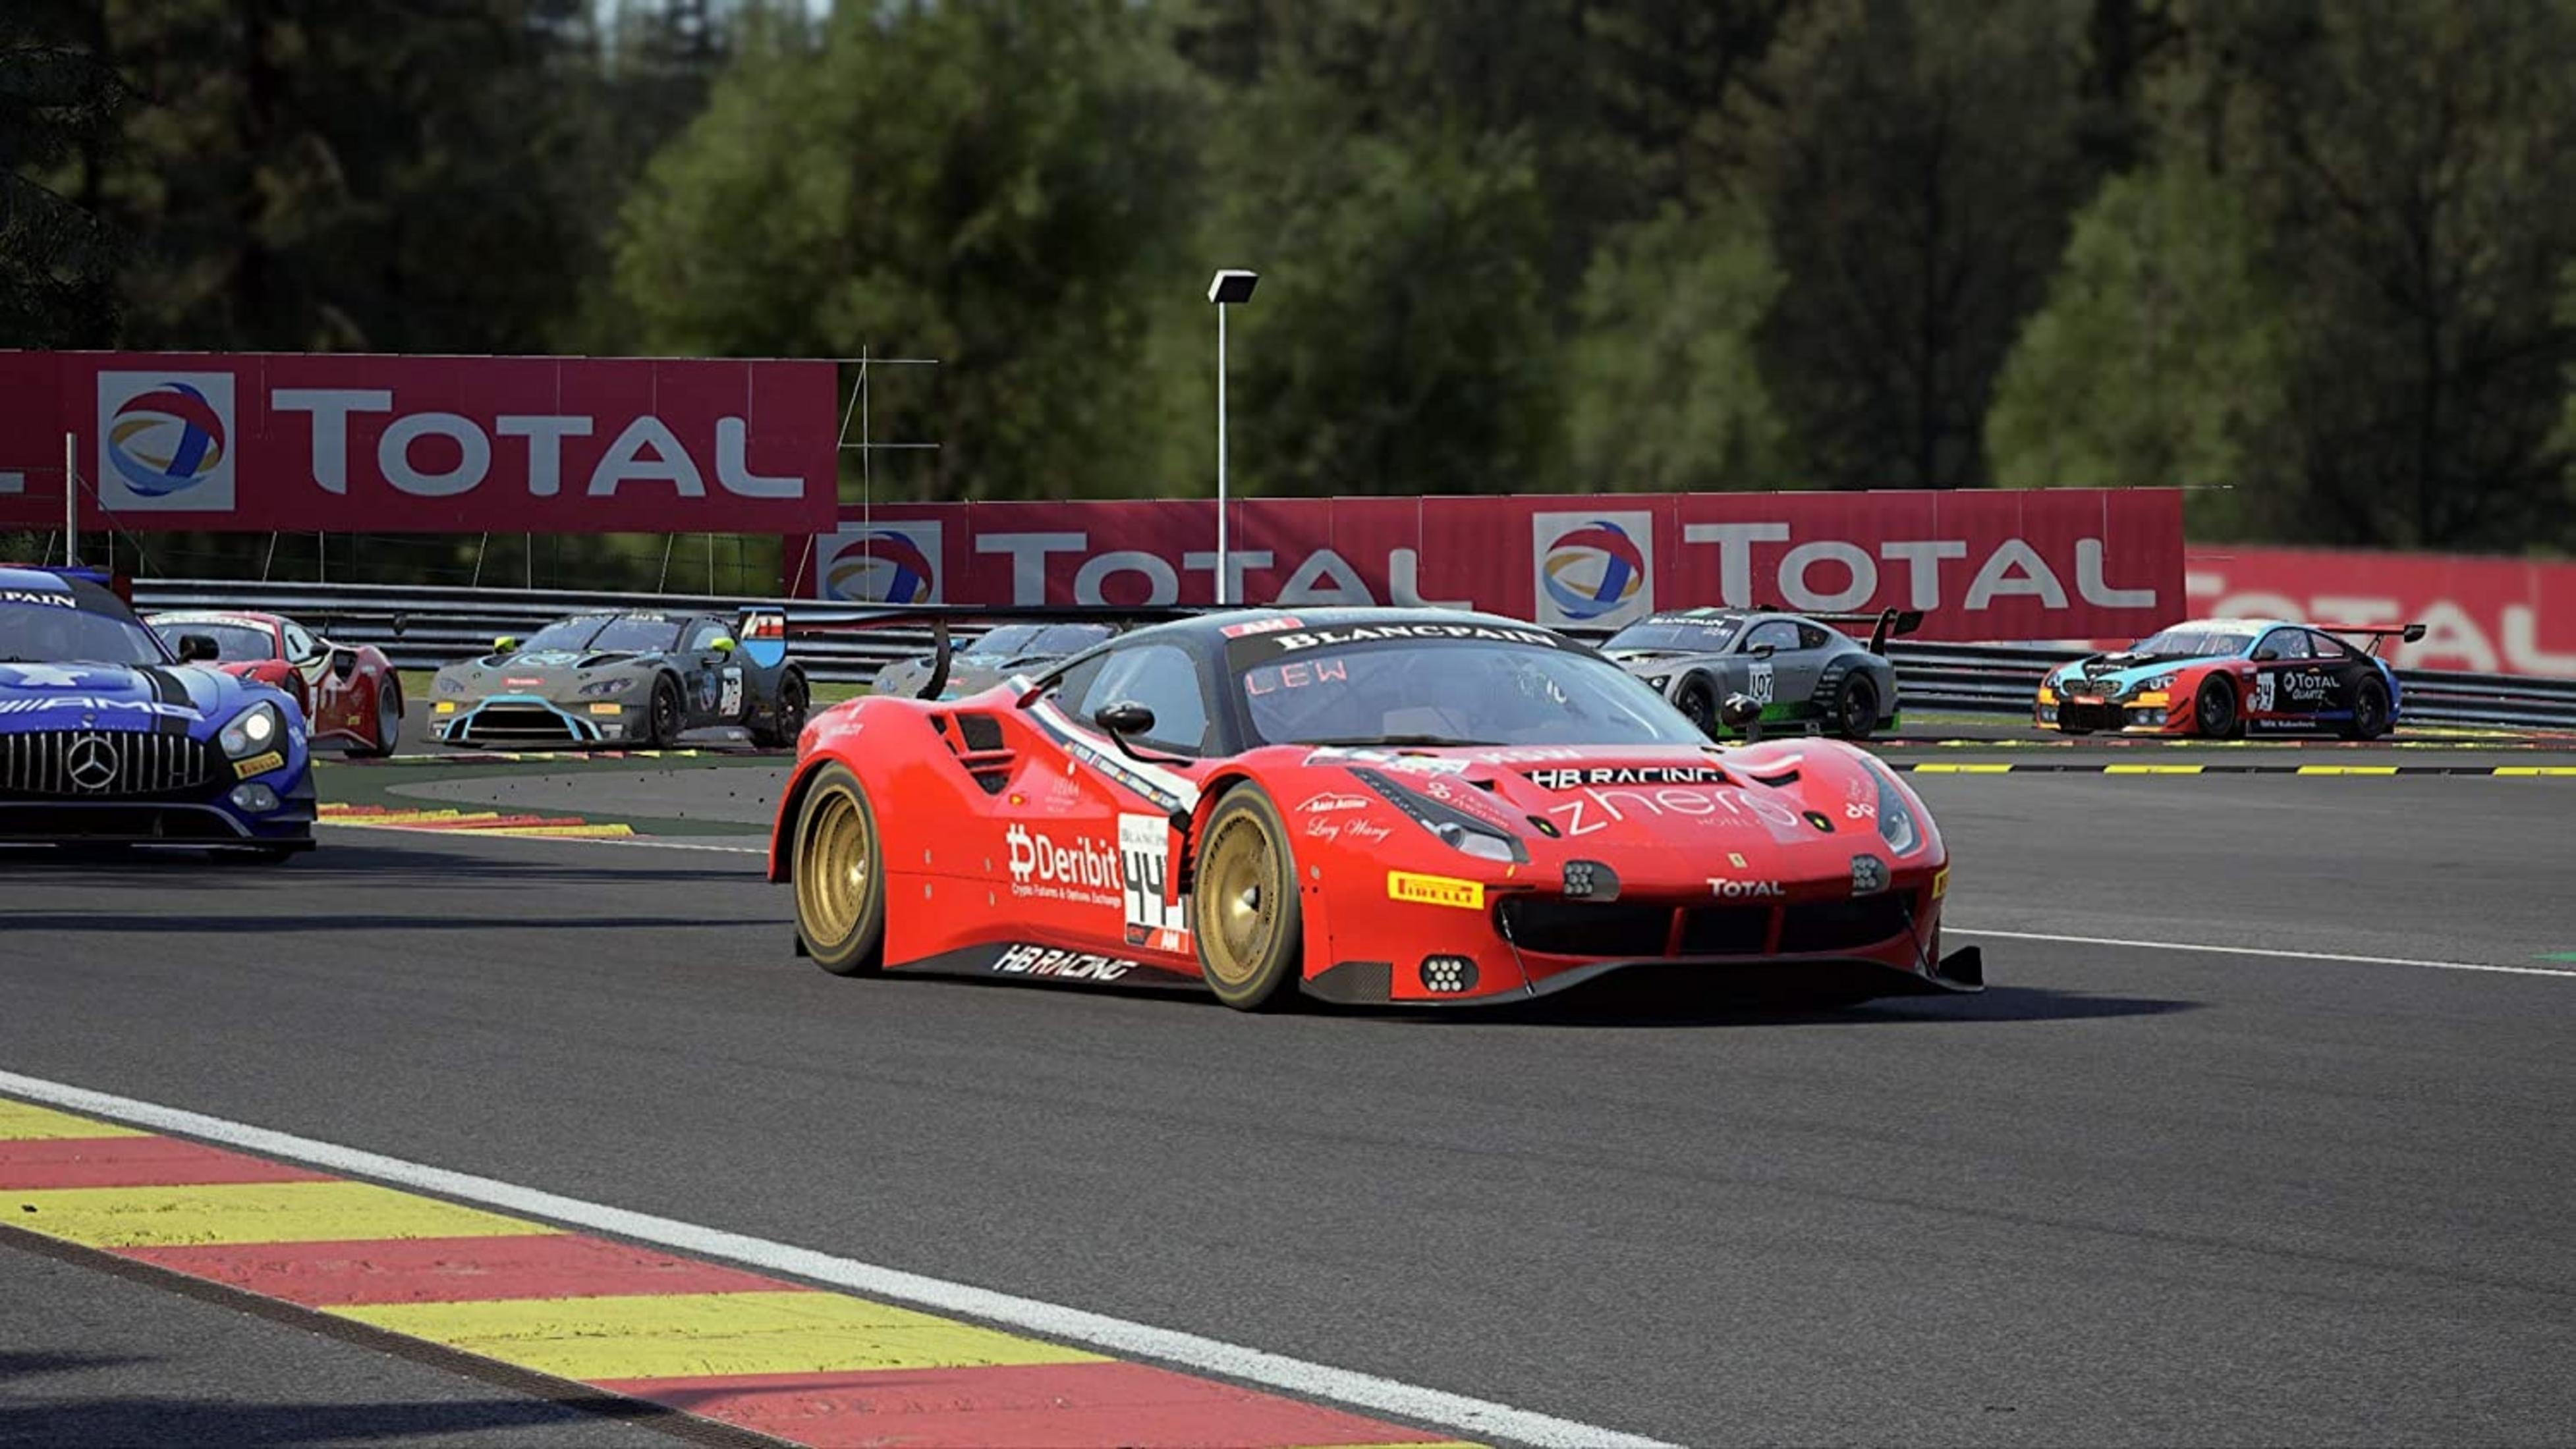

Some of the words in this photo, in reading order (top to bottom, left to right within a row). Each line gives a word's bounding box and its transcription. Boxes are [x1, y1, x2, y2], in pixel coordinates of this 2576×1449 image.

[271, 389, 804, 497] TOTAL
[976, 532, 1472, 610] TOTAL
[1684, 524, 2156, 609] TOTAL
[0, 592, 76, 608] PAIN
[1241, 618, 1285, 635] AM
[1272, 624, 1557, 651] BLANCPAIN
[1245, 659, 1348, 696] LEW
[2295, 672, 2341, 689] TOTAL
[1532, 769, 1582, 790] HB
[1036, 834, 1120, 889] Deribit
[1397, 879, 1473, 903] PIRELLI
[1706, 878, 1785, 896] TOTAL
